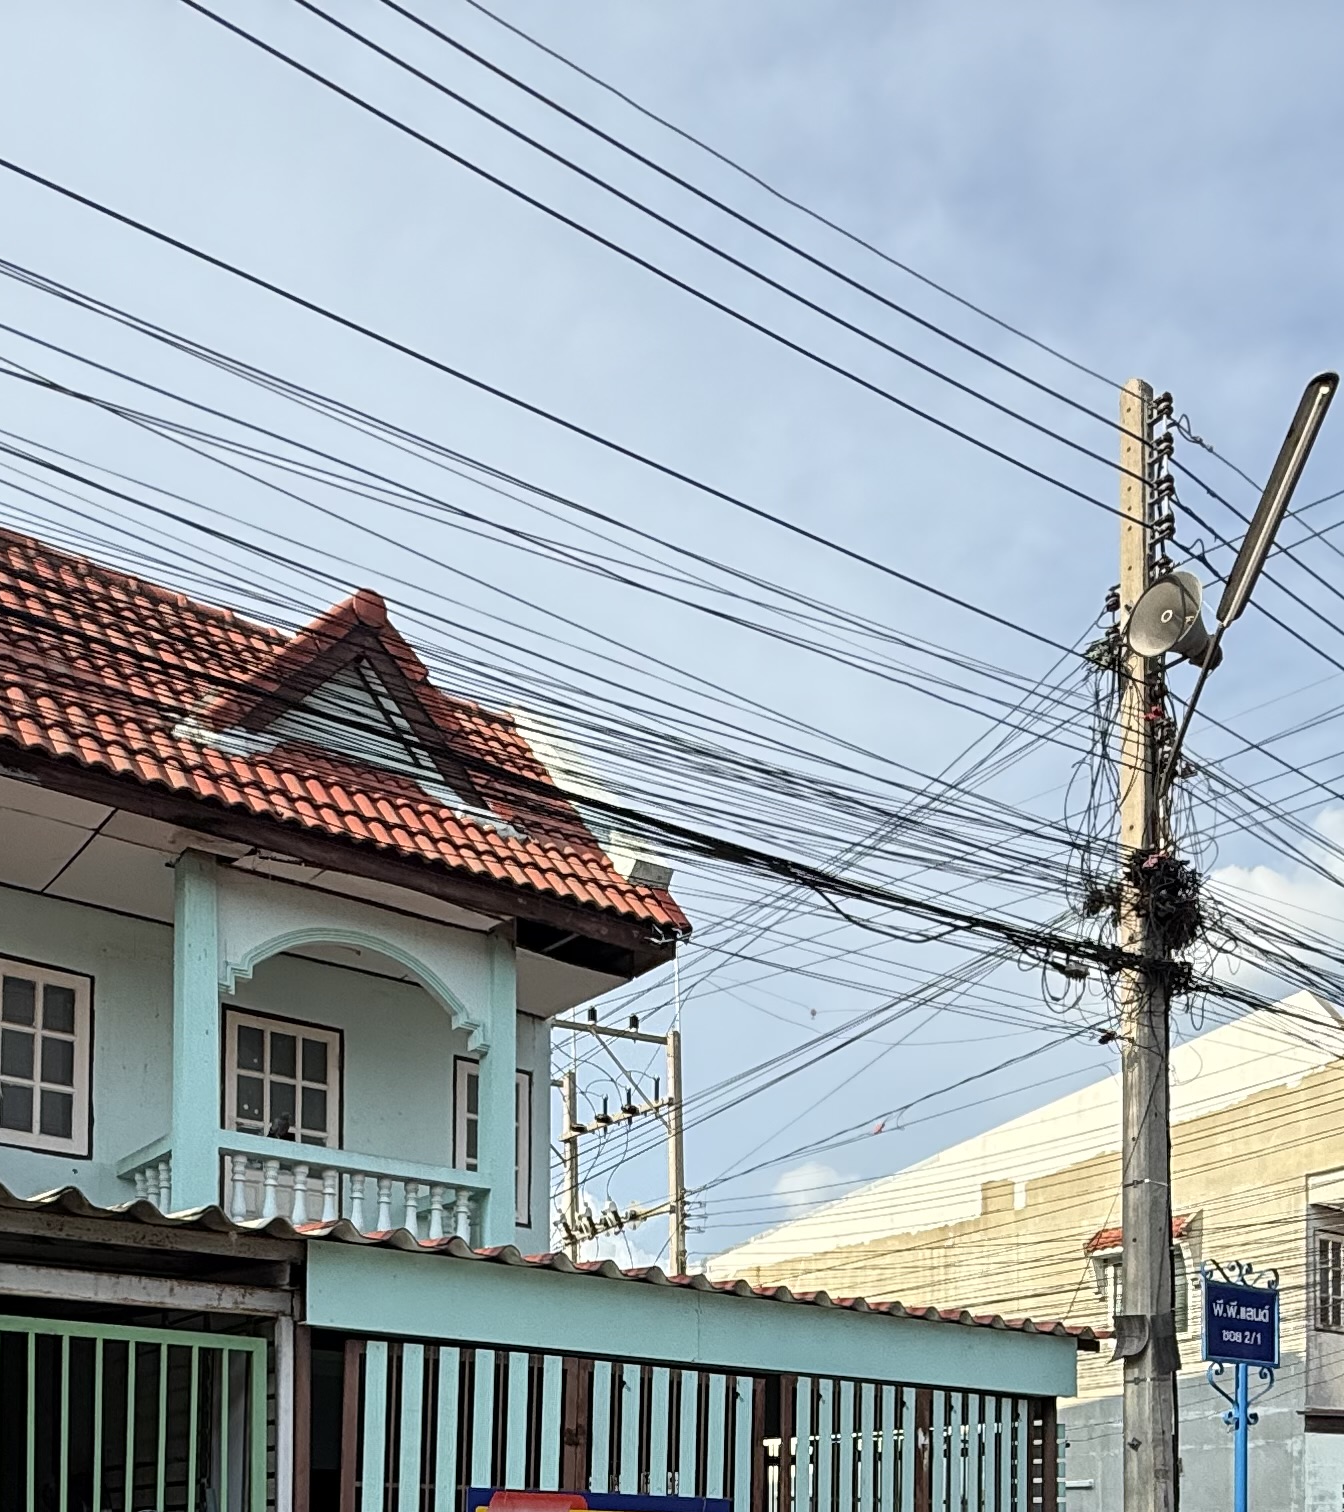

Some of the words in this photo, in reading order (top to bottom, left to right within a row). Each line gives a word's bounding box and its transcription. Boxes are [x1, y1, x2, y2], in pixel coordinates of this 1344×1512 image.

[1212, 1299, 1270, 1323] พี.พี.แลนด์
[1222, 1329, 1243, 1343] ซอย
[1244, 1331, 1262, 1345] 2/1
